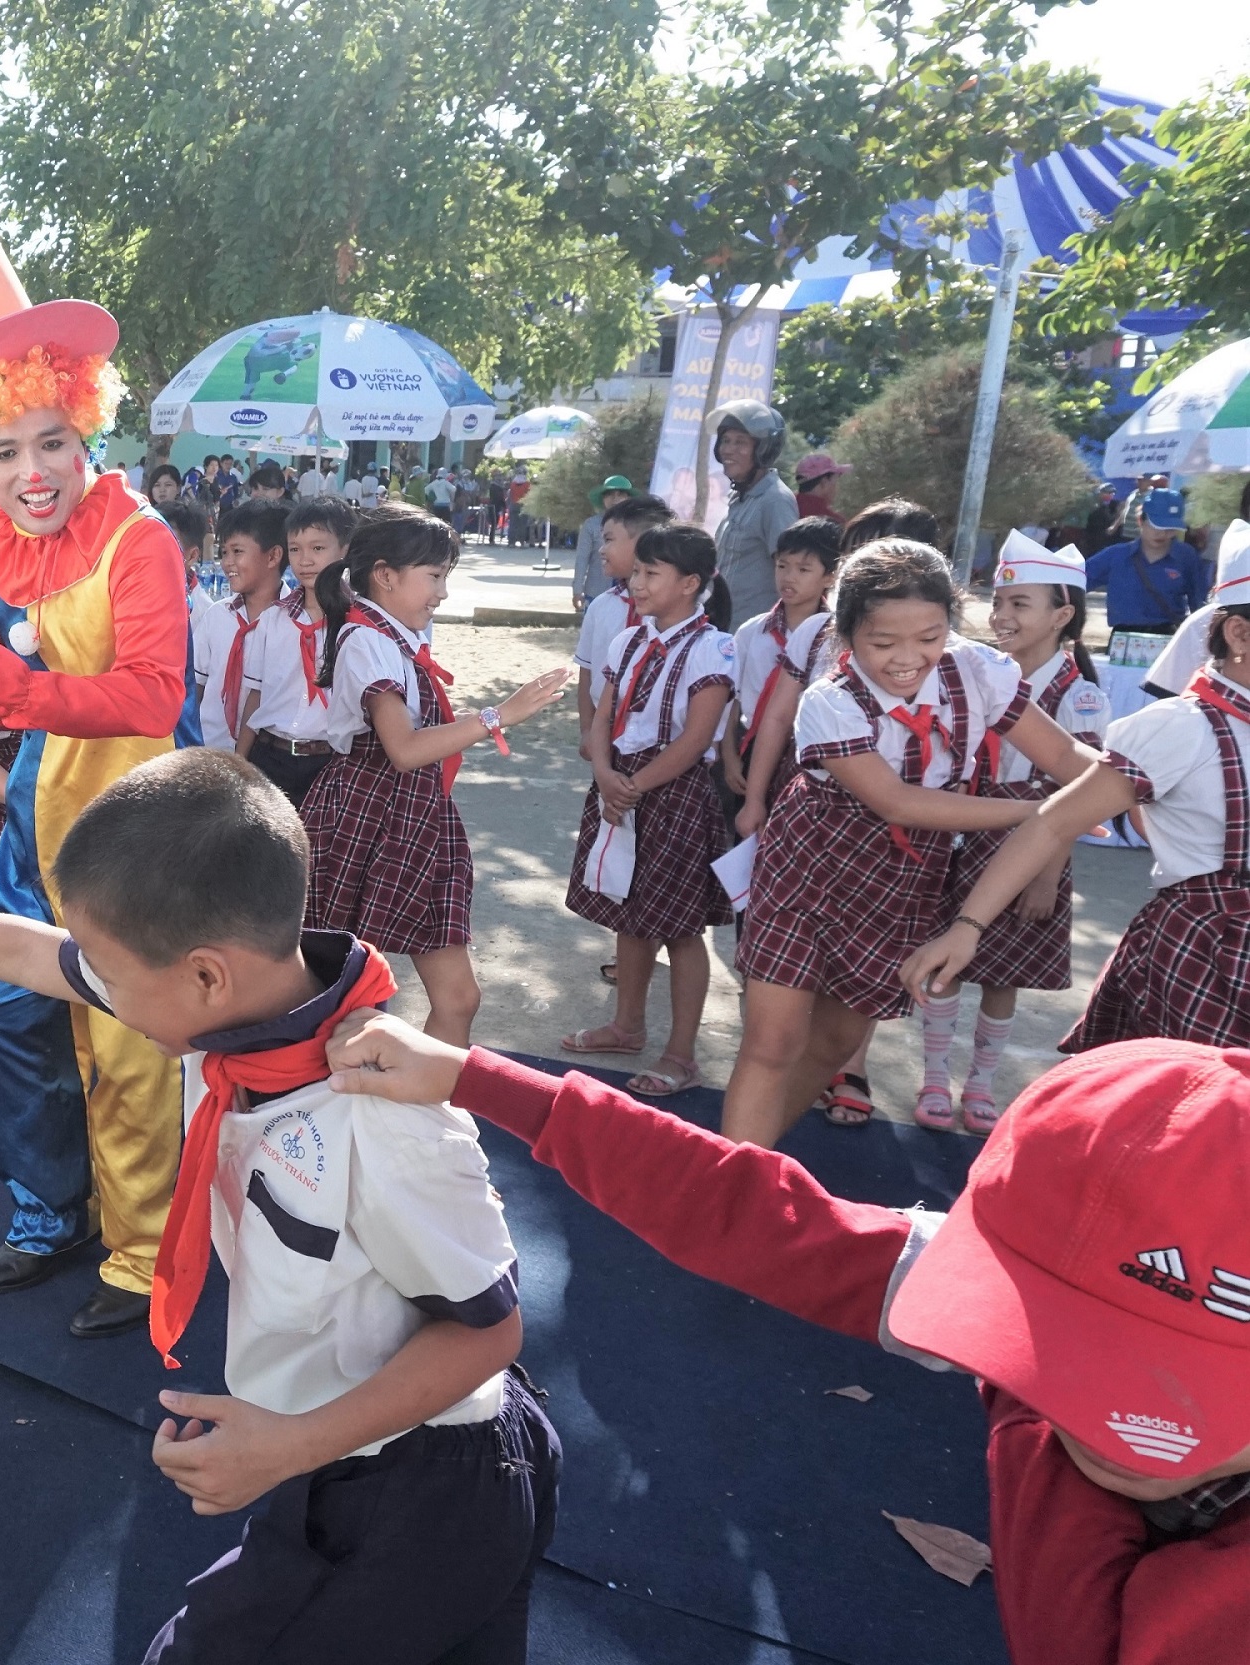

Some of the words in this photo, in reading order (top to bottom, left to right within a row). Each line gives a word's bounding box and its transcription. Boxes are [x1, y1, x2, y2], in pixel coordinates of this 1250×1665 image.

[396, 374, 422, 382] CAO
[232, 413, 266, 422] VINAMILK
[1118, 1262, 1196, 1303] adidas
[1125, 1412, 1180, 1433] adidas
